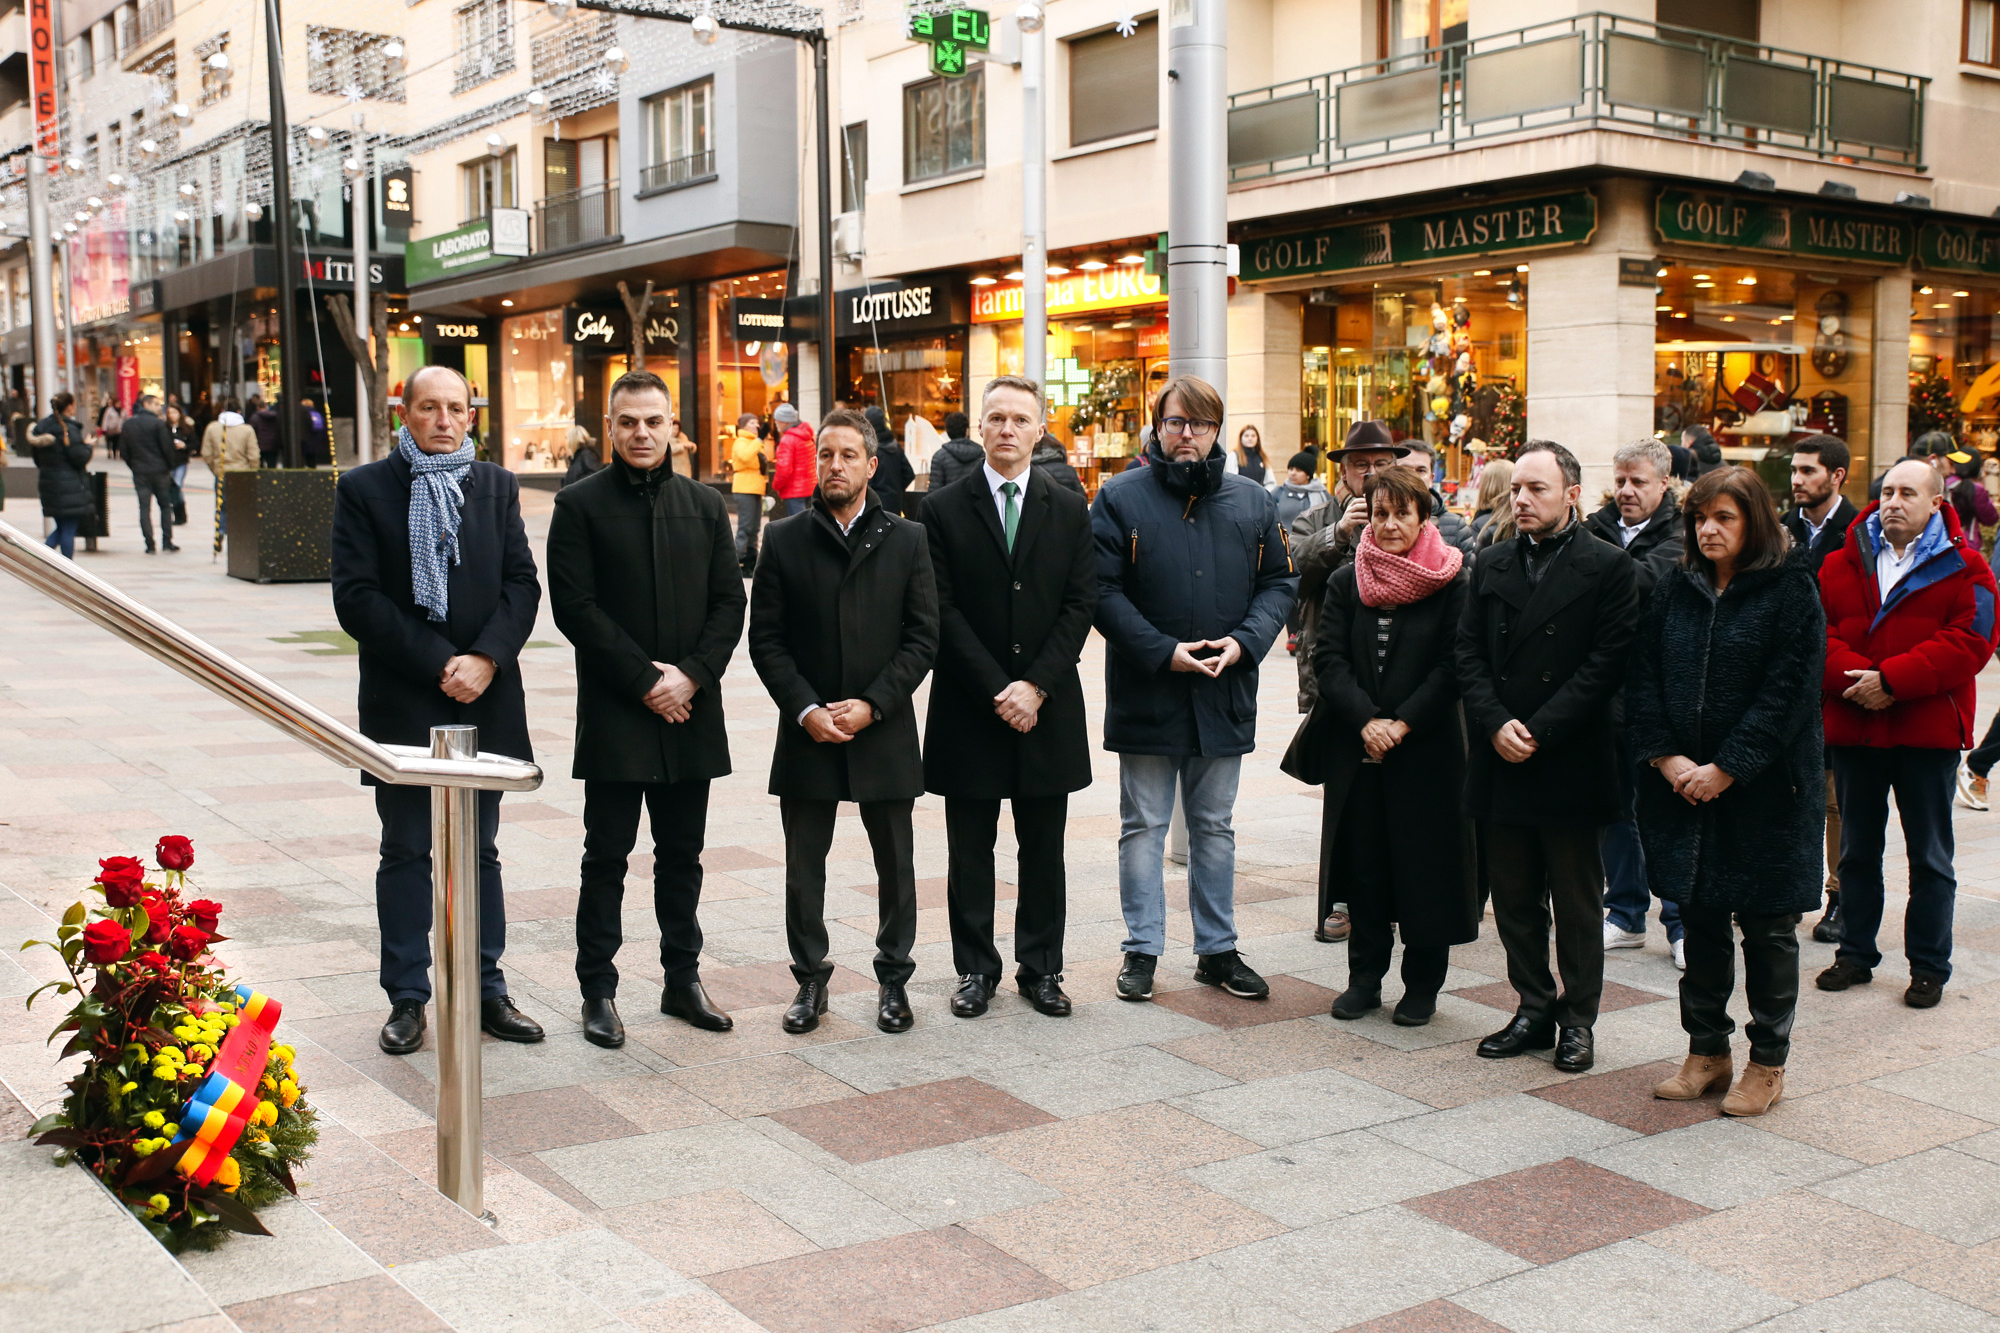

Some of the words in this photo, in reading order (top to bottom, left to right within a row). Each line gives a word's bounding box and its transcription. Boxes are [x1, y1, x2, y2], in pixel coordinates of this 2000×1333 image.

[1255, 236, 1330, 273] GOLF
[1423, 204, 1564, 251] MASTER
[1677, 201, 1747, 237] GOLF
[1807, 216, 1901, 255] MASTER
[1937, 231, 1990, 264] GOLF
[303, 256, 383, 284] MÍTIS
[852, 286, 932, 324] LOTTUSSE
[974, 276, 1075, 316] farmcia
[436, 324, 479, 338] TOUS
[574, 311, 615, 344] Galy
[738, 313, 784, 328] LOTTUSSE
